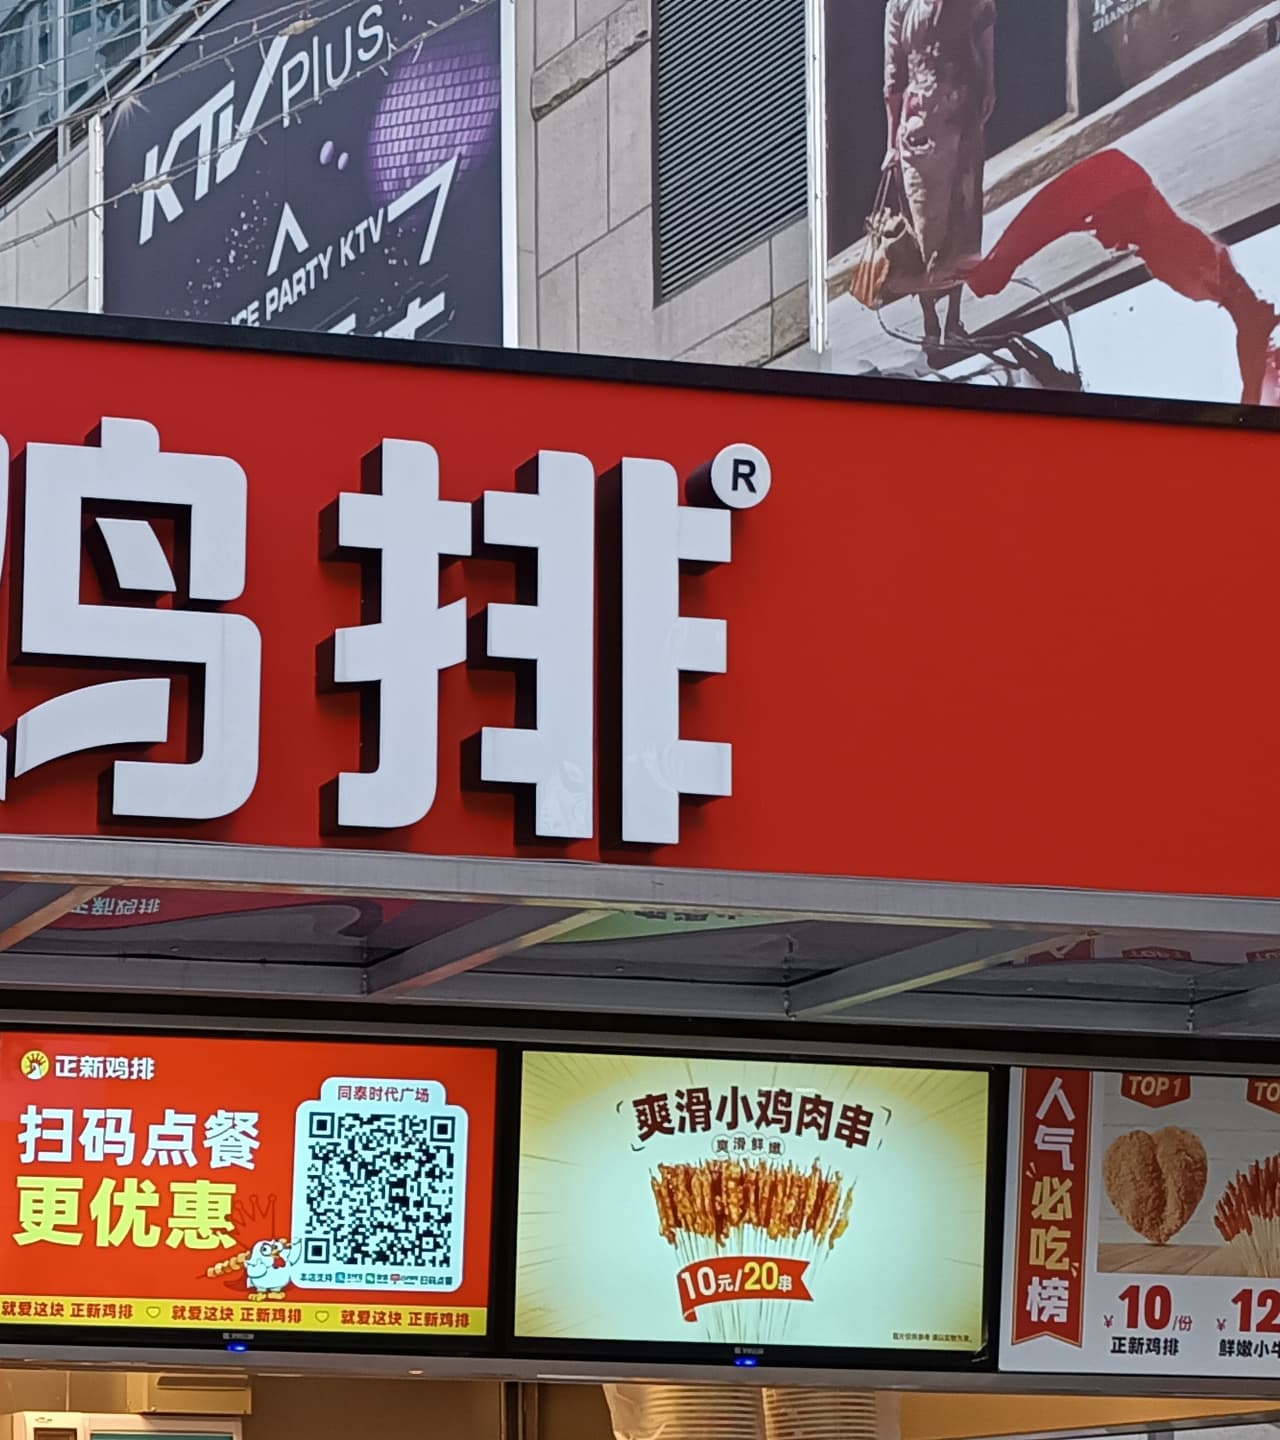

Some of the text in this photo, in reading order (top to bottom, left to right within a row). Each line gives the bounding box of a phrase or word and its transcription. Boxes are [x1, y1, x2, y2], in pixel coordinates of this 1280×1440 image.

[266, 246, 333, 320] PARTY
[340, 207, 384, 268] KTV
[54, 1055, 156, 1081] 正新鸡排
[336, 1084, 431, 1104] 同泰时代广场
[1128, 1075, 1169, 1096] TOP
[632, 1085, 875, 1150] 爽滑小鸡肉串
[16, 1105, 262, 1171] 扫码点餐
[714, 1135, 783, 1156] 爽滑鲜嫩
[1025, 1076, 1076, 1324] 人气必吃榜
[12, 1175, 238, 1250] 更优惠
[680, 1260, 793, 1301] 10元/20串
[1, 1299, 134, 1321] 就爱这块 正新鸡排
[171, 1304, 302, 1326] 就爱这块 正新鸡排
[340, 1308, 471, 1329] 就爱这块 正新鸡排
[1110, 1336, 1179, 1357] 正新鸡排
